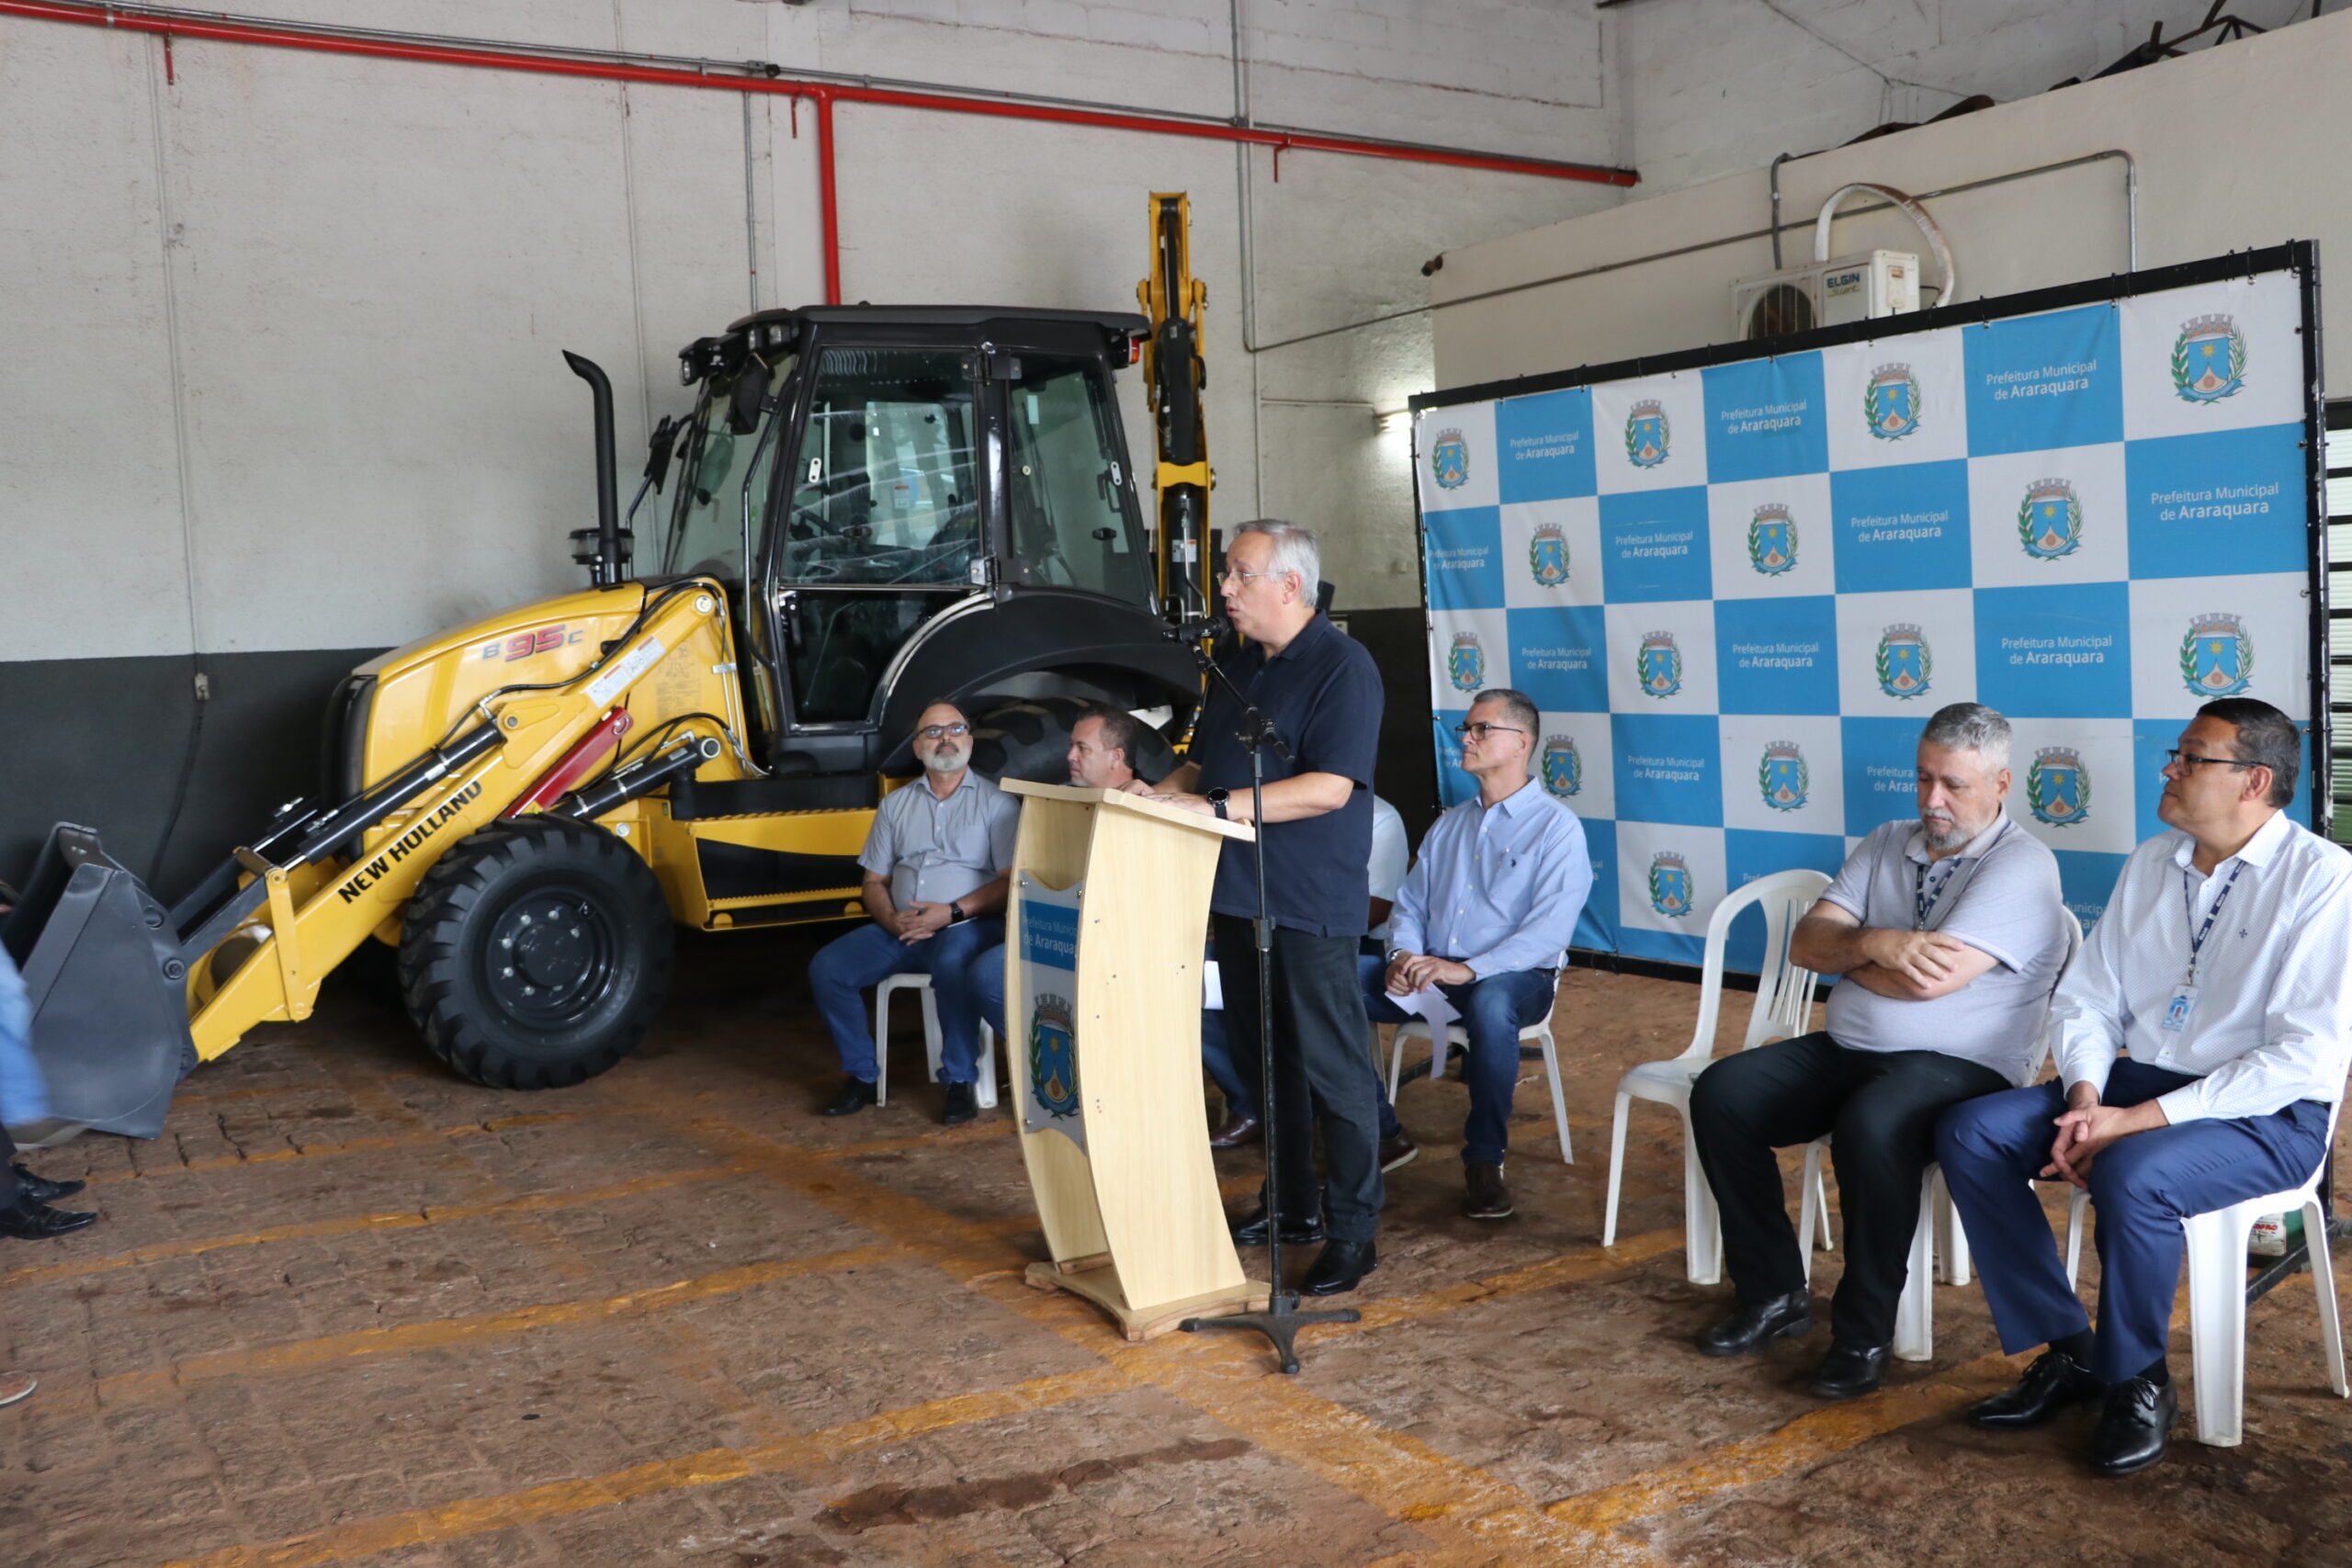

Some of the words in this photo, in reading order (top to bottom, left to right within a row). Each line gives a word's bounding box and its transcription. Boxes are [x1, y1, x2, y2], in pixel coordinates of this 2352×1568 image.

[1827, 273, 1860, 288] ELGIN
[1986, 370, 2040, 386] Prefeitura
[2042, 359, 2097, 379] Municipal
[1995, 387, 2008, 400] de
[2011, 378, 2087, 400] Araraquara
[1721, 409, 1762, 422] Prefeitura
[1765, 400, 1806, 416] Municipal
[1727, 423, 1738, 434] de
[1741, 415, 1801, 434] Araraquara
[1510, 435, 1544, 448] Prefeitura
[1544, 431, 1579, 446] Municipal
[1516, 449, 1524, 459] de
[1526, 446, 1575, 459] Araraquara
[2151, 490, 2211, 504] Prefeitura
[2215, 482, 2278, 501] Municipal
[2160, 507, 2176, 520] de
[2178, 500, 2268, 520] Araraquara
[1851, 513, 1897, 528] Prefeitura
[1900, 510, 1948, 525] Municipal
[1616, 535, 1653, 546] Prefeitura
[1655, 531, 1693, 544] Municipal
[1859, 529, 1871, 542] de
[1872, 525, 1941, 542] Araraquara
[1622, 548, 1632, 558] de
[1634, 544, 1688, 558] Araraquara
[1442, 557, 1485, 570] Araraquara
[1733, 644, 1773, 654] Prefeitura
[1776, 642, 1818, 655] Municipal
[2002, 637, 2054, 649] Prefeitura
[2058, 635, 2112, 649] Municipal
[1521, 647, 1555, 657] Prefeitura
[1557, 647, 1591, 660] Municipal
[2010, 652, 2023, 664] de
[2026, 650, 2104, 667] Araraquara
[1527, 660, 1536, 670] de
[1538, 658, 1587, 671] Araraquara
[1739, 657, 1750, 668] de
[1752, 655, 1813, 670] Araraquara
[1627, 755, 1664, 766] Prefeitura
[1667, 757, 1704, 770] Municipal
[1634, 769, 1644, 779] de
[1645, 768, 1700, 782] Araraquara
[1867, 766, 1914, 778] Prefeitura
[1874, 780, 1886, 791] de
[338, 857, 390, 904] NEW
[389, 780, 482, 863] HOLLAND
[1023, 934, 1034, 947] de
